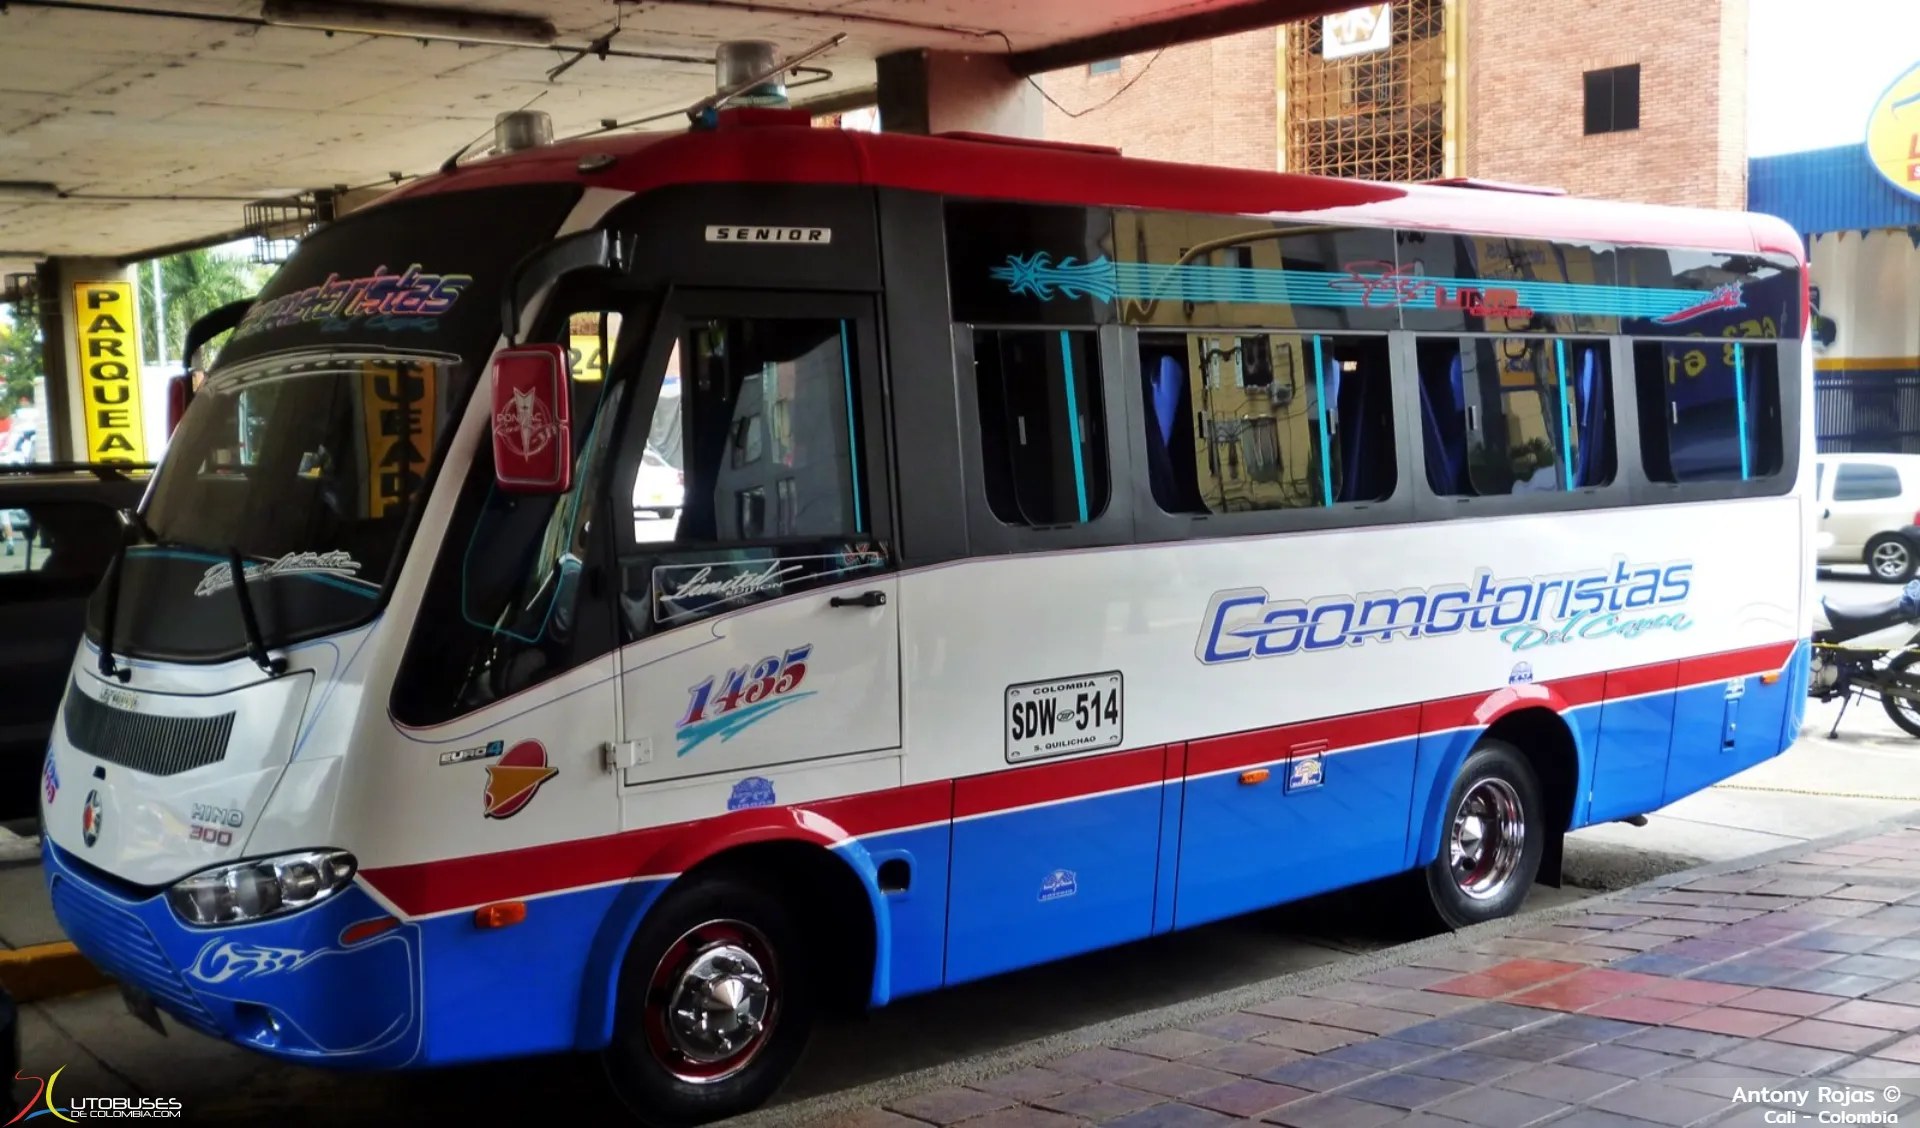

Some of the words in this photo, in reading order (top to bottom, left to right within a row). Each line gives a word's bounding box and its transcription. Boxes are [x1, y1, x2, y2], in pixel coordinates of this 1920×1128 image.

[716, 227, 822, 241] SENIOR
[86, 289, 136, 465] PARQUEA
[1202, 558, 1694, 663] Coomotoristas
[676, 643, 814, 729] 1435
[1032, 680, 1096, 695] COLOMBIA
[1012, 697, 1057, 741] SDW
[1075, 688, 1119, 731] 514
[1045, 735, 1096, 750] QUILICHAO
[191, 802, 244, 828] HINO
[189, 825, 233, 847] 300
